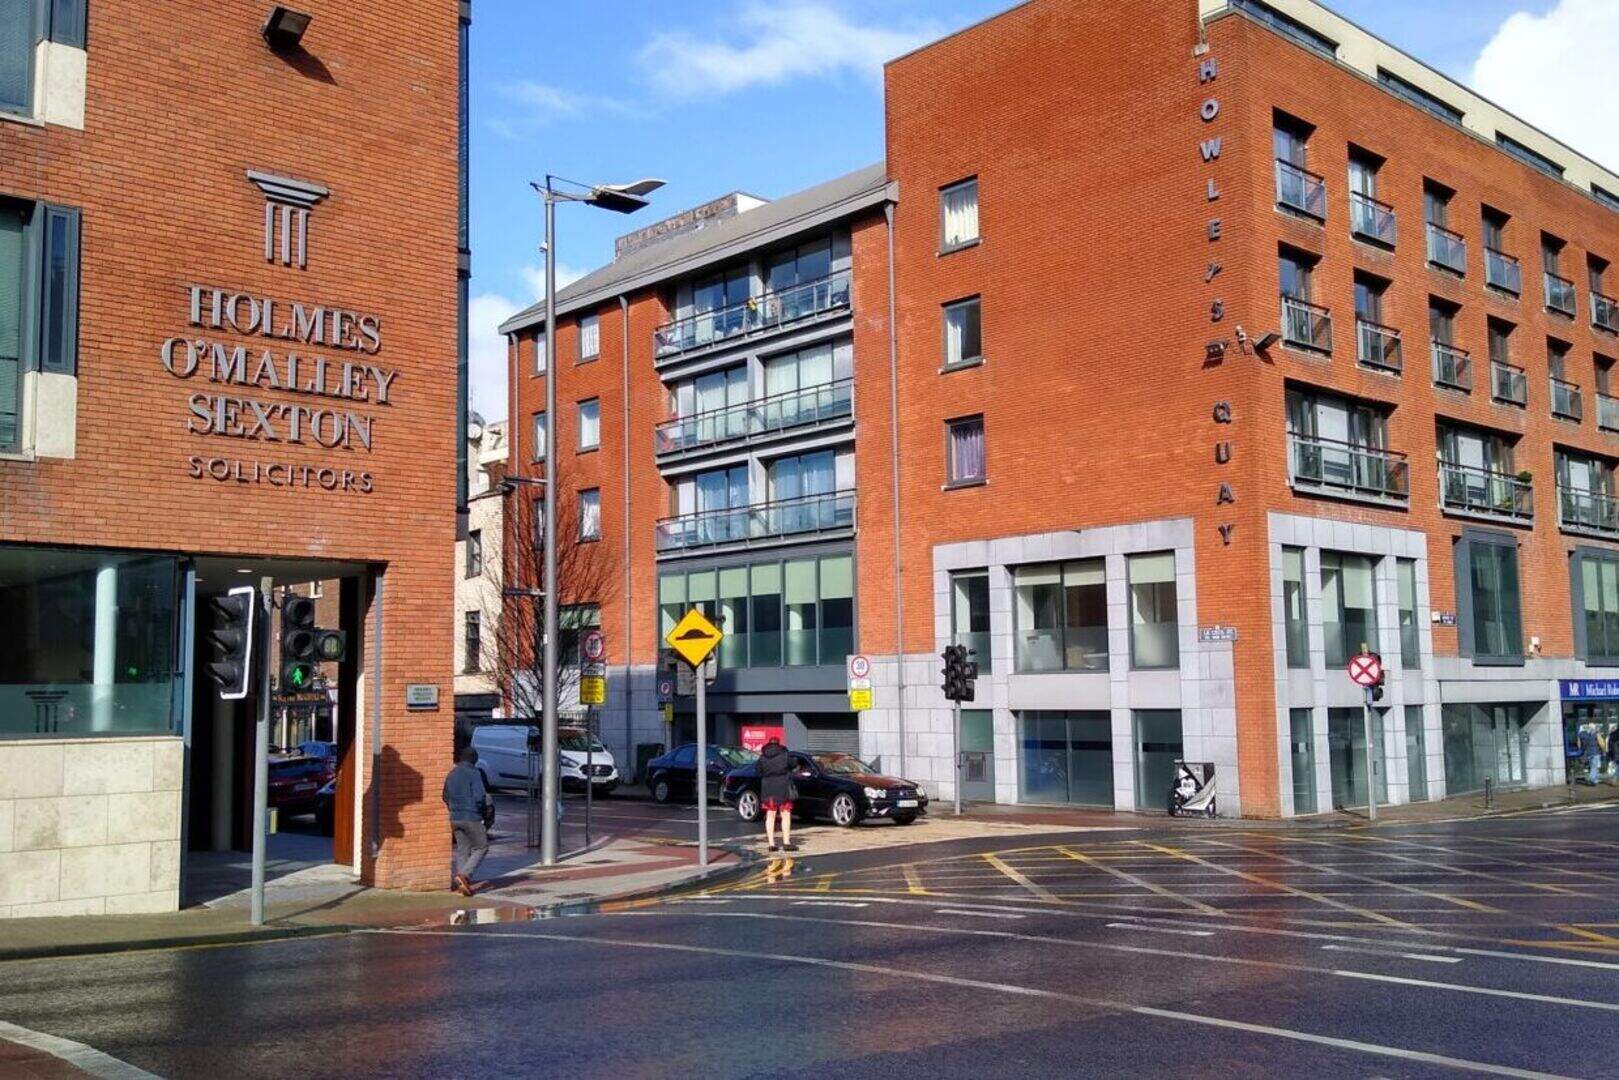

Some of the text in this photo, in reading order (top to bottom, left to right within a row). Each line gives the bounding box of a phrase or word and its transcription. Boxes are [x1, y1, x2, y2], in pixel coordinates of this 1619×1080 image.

[186, 285, 381, 354] HOLMES
[160, 337, 399, 405] O’MALLEY
[187, 394, 375, 451] SEXTON
[188, 456, 374, 492] SOLICITORS
[1212, 401, 1234, 545] QUAY
